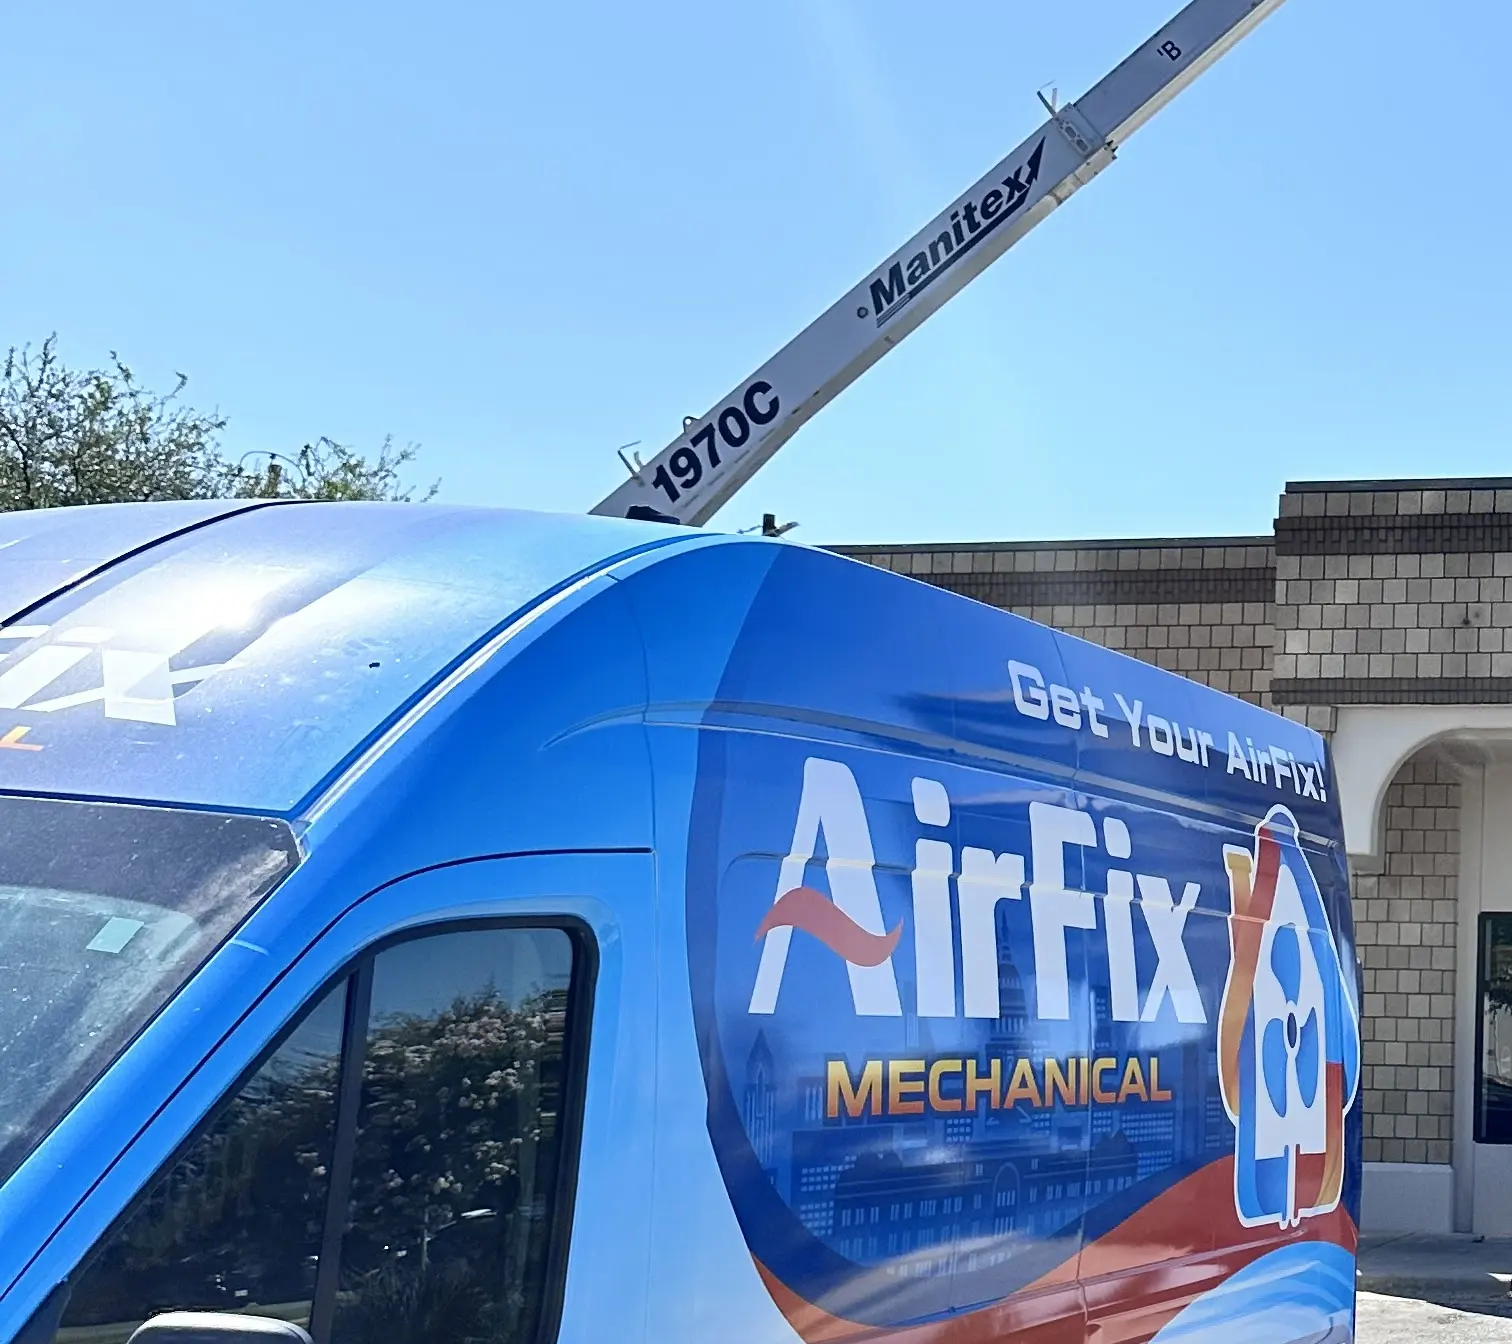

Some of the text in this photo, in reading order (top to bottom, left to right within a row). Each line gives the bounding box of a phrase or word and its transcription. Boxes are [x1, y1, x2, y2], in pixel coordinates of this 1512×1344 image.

[869, 156, 1034, 318] Manitex
[651, 380, 780, 504] 1970C
[1007, 659, 1327, 803] Get Your AirFix!
[748, 756, 1207, 1024] AirFix
[826, 1057, 1172, 1118] MECHANICAL
